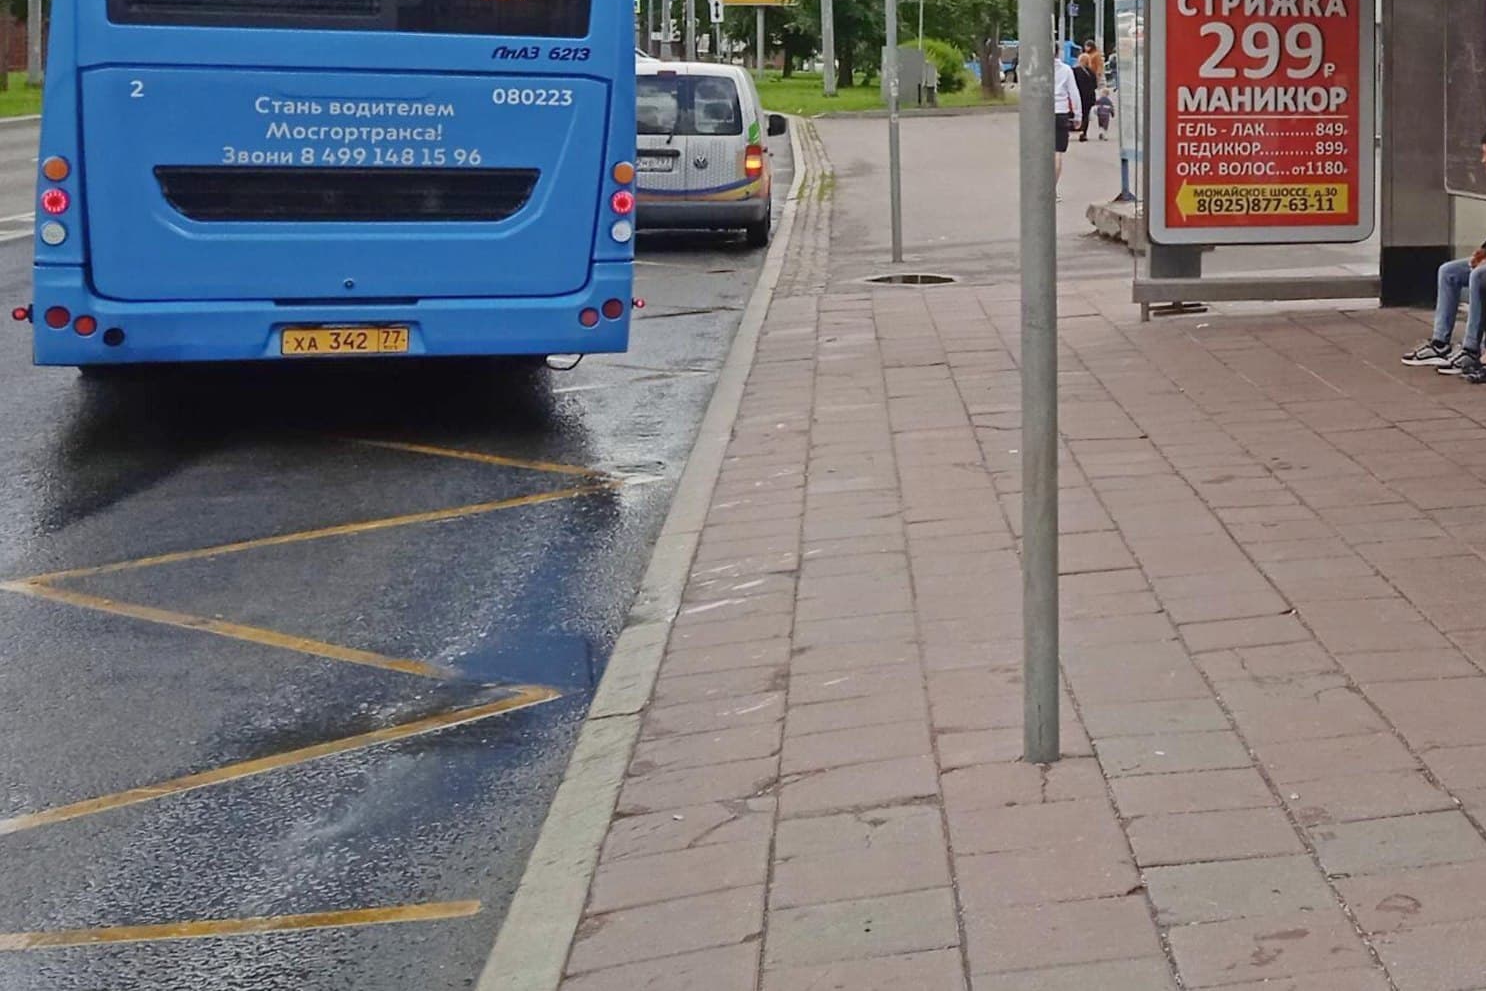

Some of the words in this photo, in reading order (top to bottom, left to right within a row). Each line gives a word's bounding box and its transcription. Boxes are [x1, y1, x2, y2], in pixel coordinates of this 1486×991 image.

[548, 47, 591, 61] 6213
[130, 80, 145, 97] 2
[492, 88, 573, 106] 080223
[255, 96, 322, 114] Стань
[329, 100, 455, 117] водителем
[1177, 86, 1348, 113] МАНИКЮР
[265, 122, 443, 144] Мосгортранса!
[1177, 123, 1217, 137] ГЕЛЬ
[222, 146, 293, 165] Звони
[300, 147, 314, 165] 8
[322, 147, 366, 165] 499
[373, 148, 415, 165] 148
[422, 148, 446, 165] 15
[454, 148, 482, 166] 96
[1176, 162, 1213, 176] ОКР.
[1193, 186, 1267, 198] МОЖАЙСКОЕ
[1197, 197, 1335, 214] 8(925)877-63-11
[293, 336, 319, 351] ХА
[329, 331, 368, 350] 342
[382, 330, 401, 344] 77
